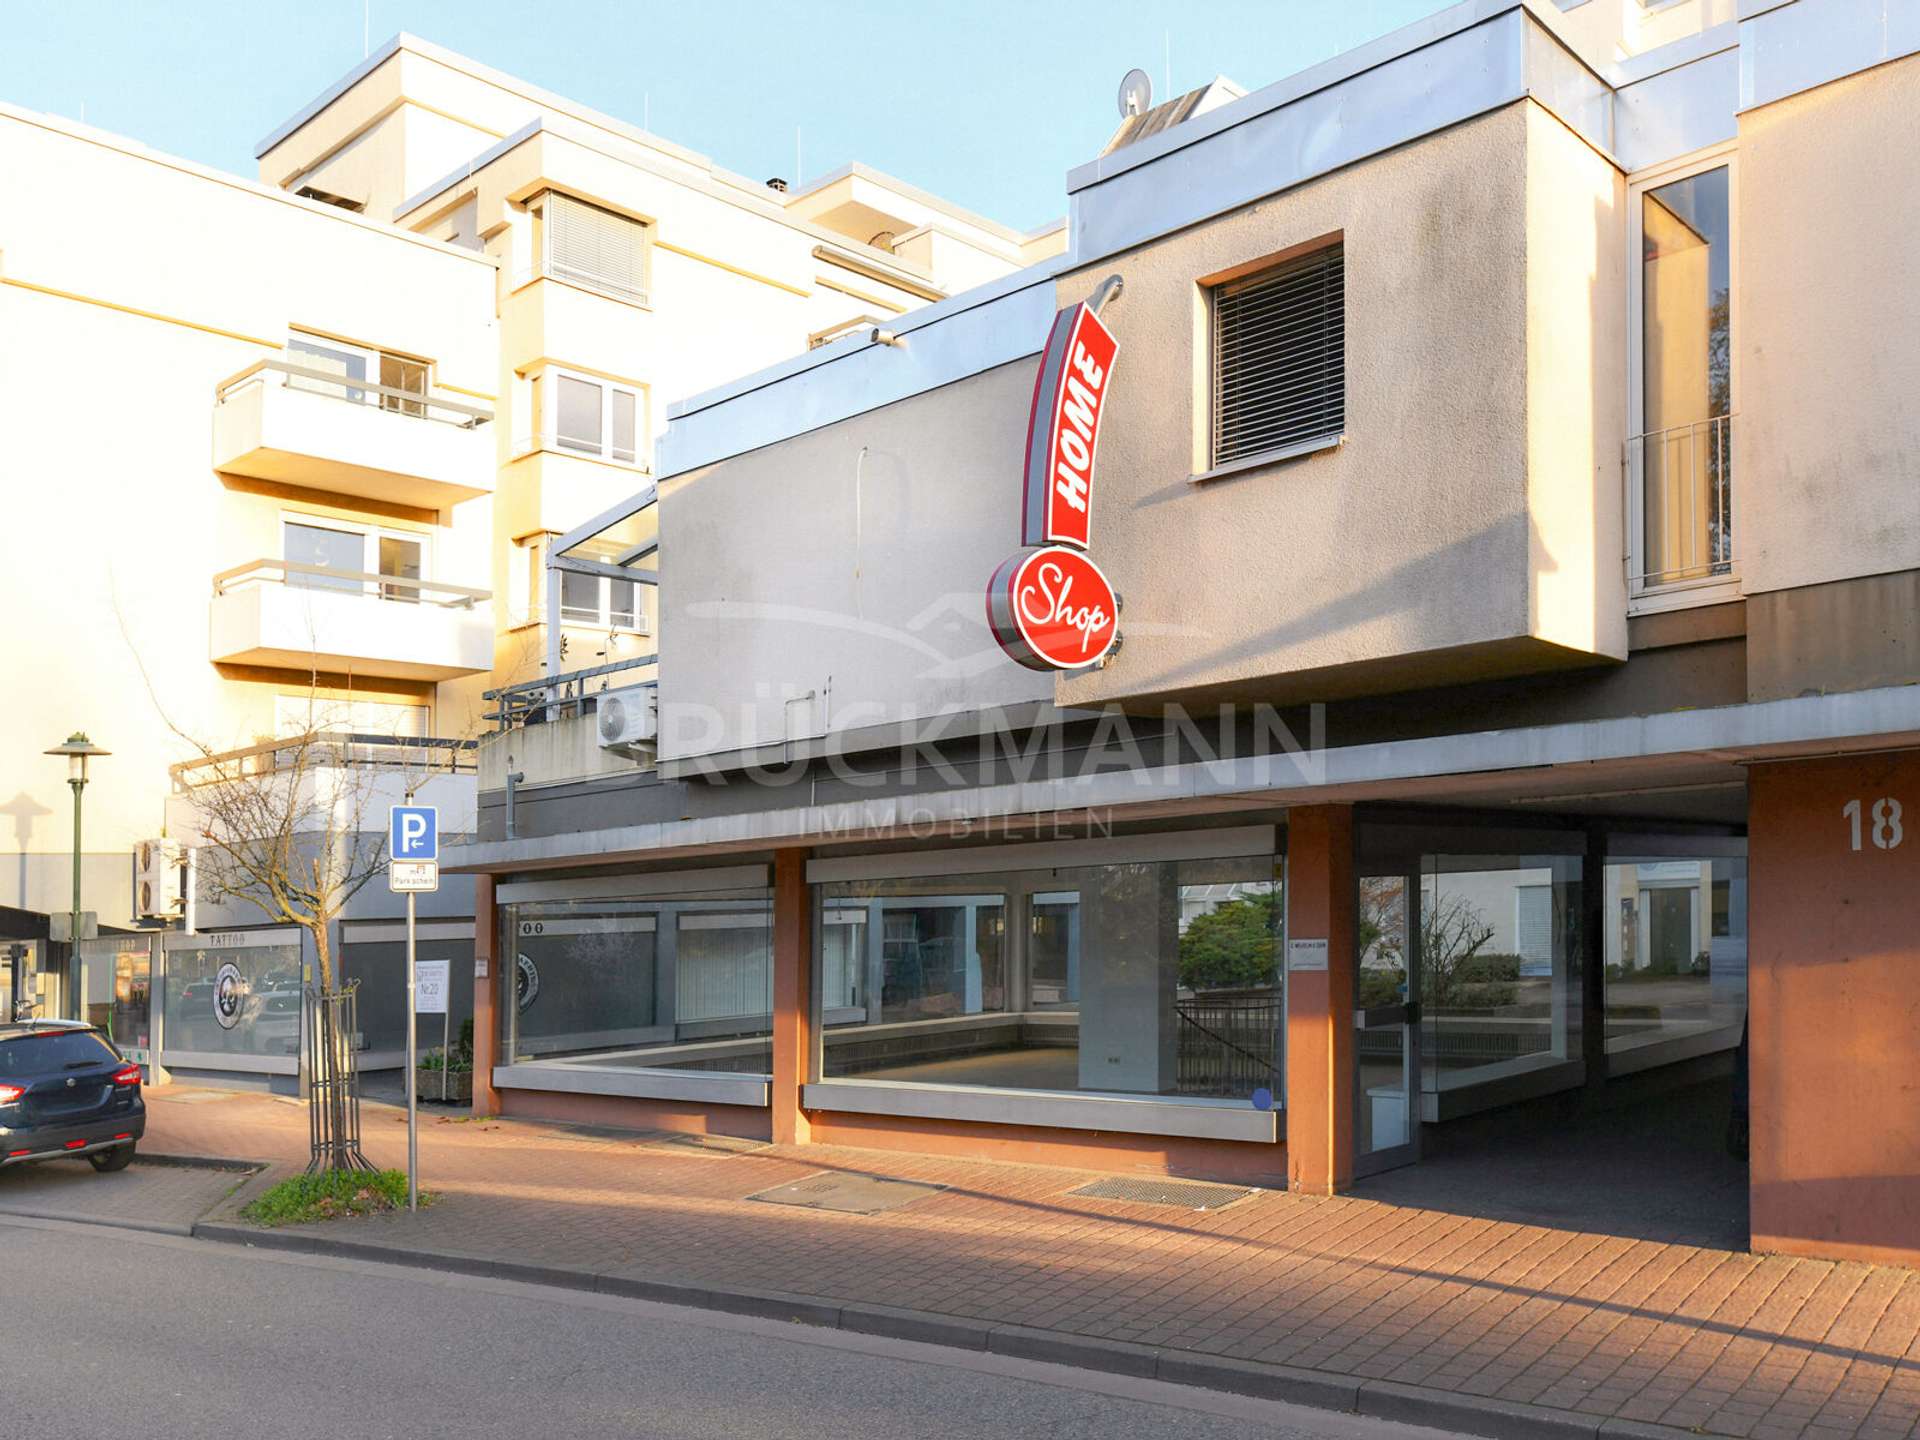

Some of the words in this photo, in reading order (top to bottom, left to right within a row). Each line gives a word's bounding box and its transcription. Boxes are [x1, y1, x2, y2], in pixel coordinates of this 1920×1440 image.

[1055, 341, 1103, 513] HOME
[1021, 563, 1110, 653] Shop
[402, 813, 427, 853] P
[1842, 797, 1904, 850] 18
[210, 934, 245, 947] TATTOO
